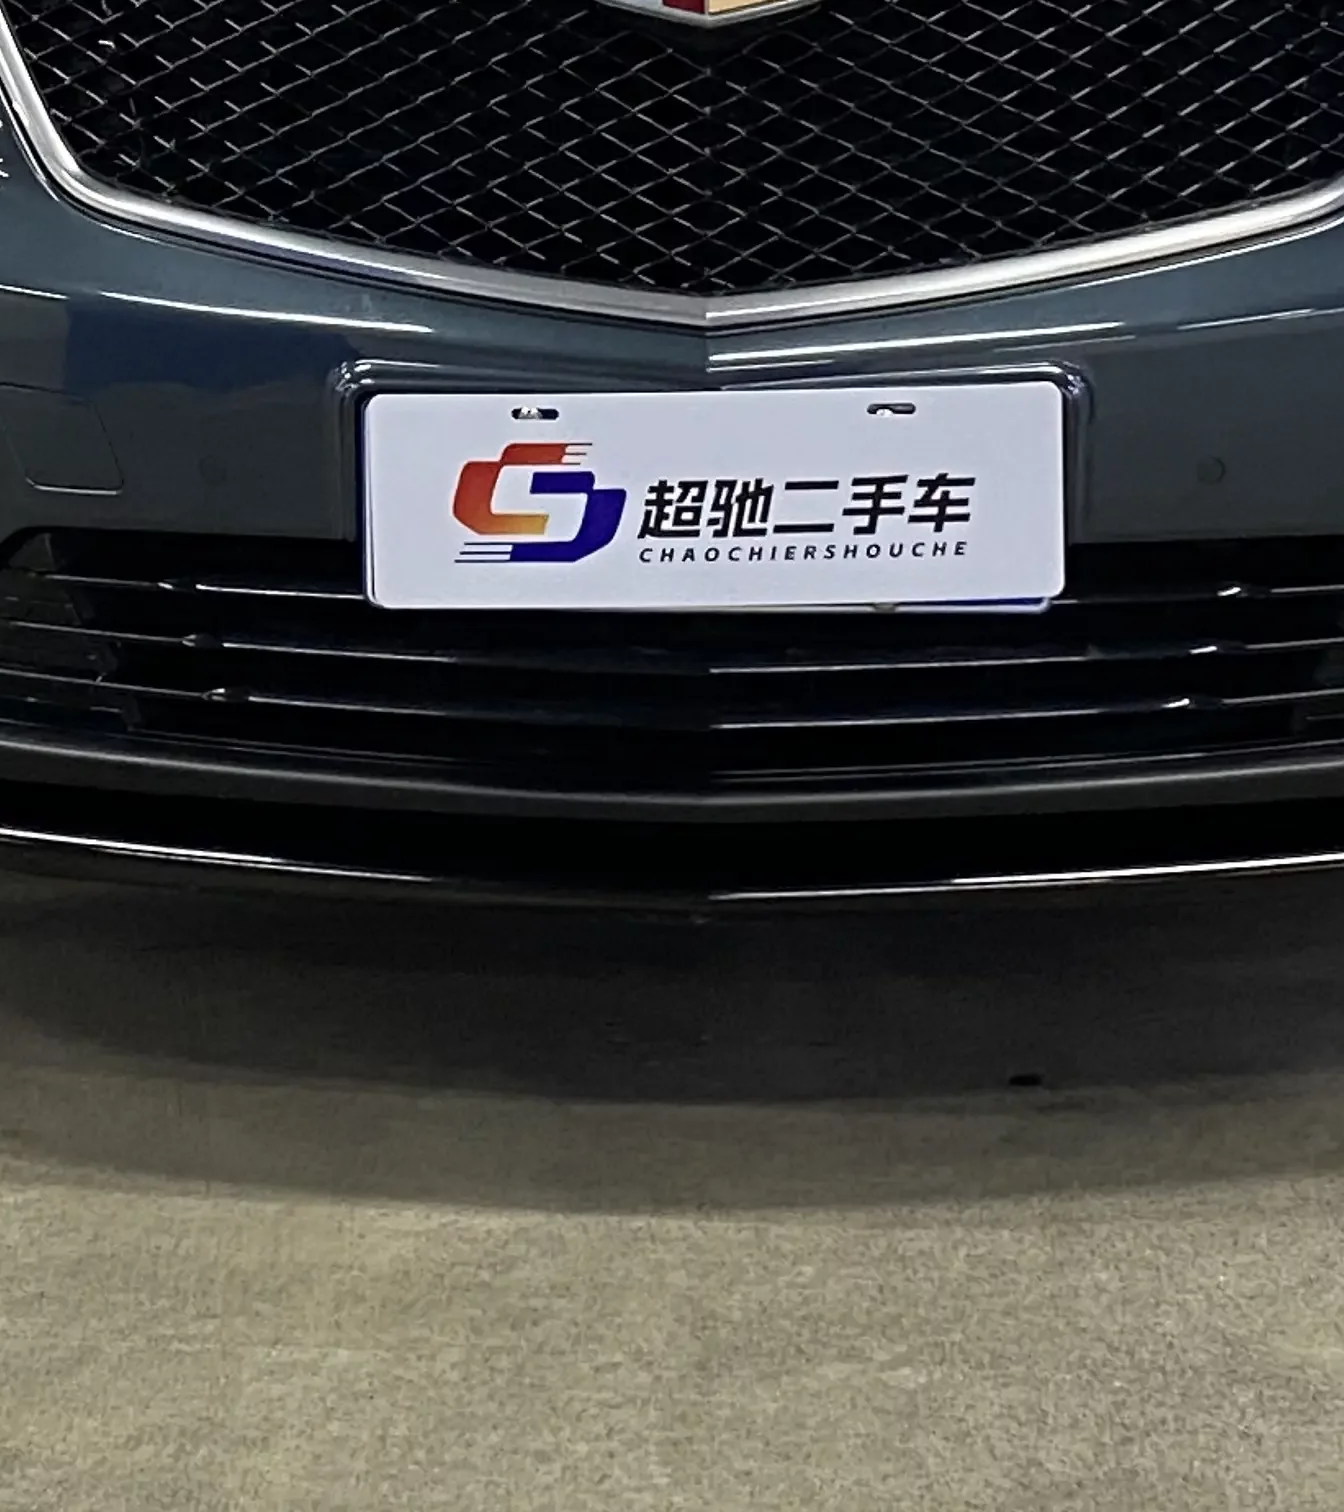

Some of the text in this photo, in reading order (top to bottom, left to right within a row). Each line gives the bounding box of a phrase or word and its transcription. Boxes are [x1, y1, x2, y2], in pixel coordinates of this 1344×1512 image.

[637, 472, 976, 540] 超驰二手车
[638, 541, 968, 563] CHAOCHIERSHOUCHE
